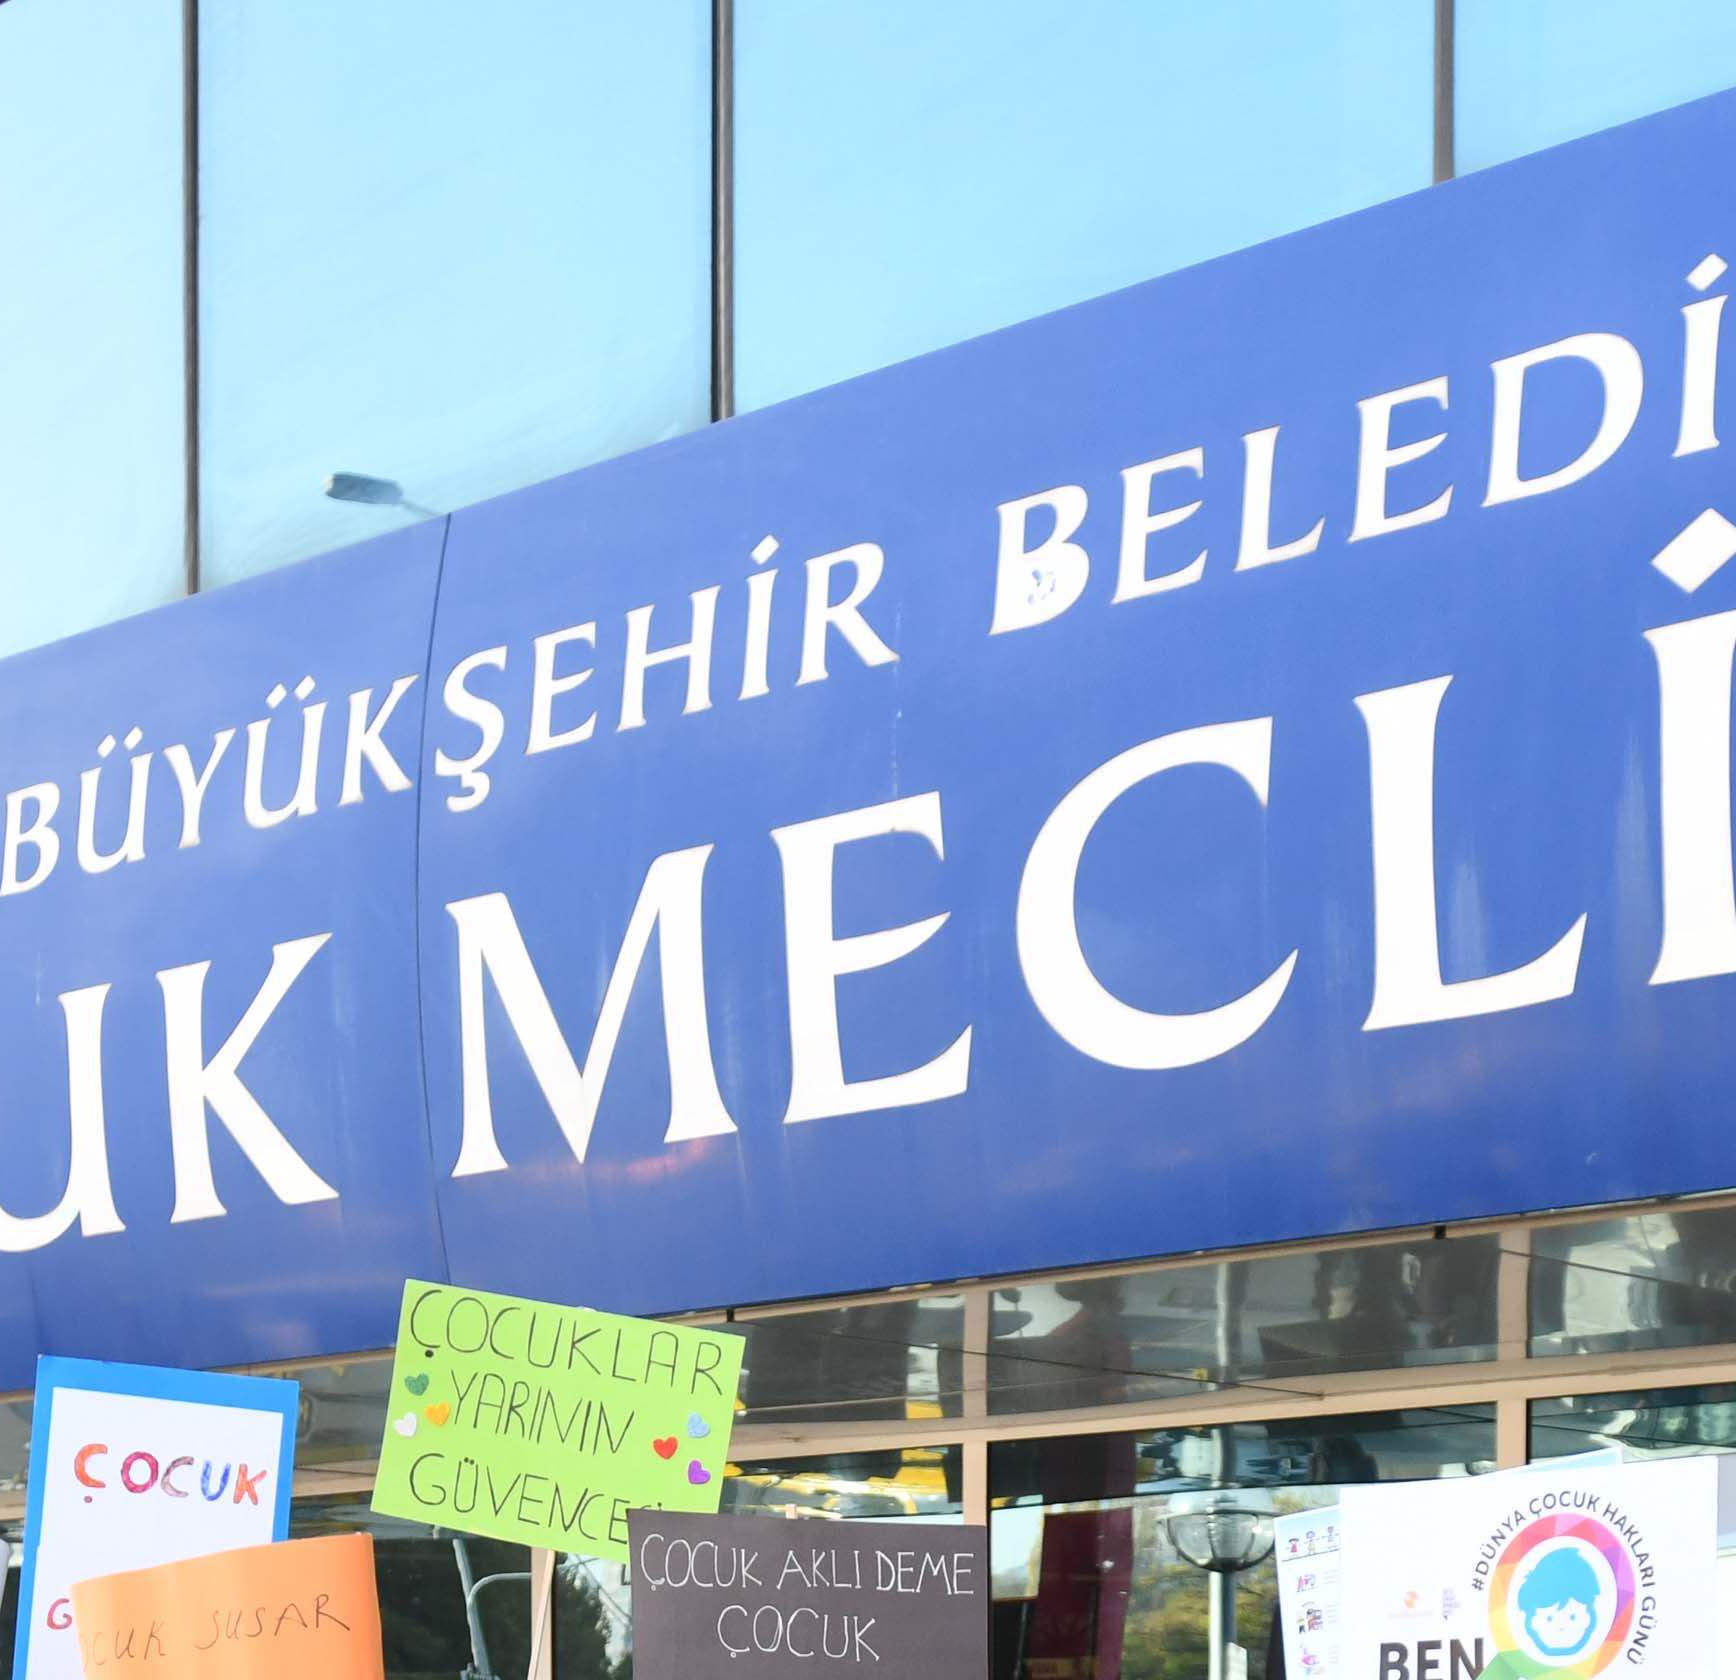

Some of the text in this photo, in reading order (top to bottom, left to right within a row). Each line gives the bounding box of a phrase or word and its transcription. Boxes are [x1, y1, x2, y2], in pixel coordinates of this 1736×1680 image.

[408, 1287, 726, 1397] ÇOCUKLAR
[450, 1369, 636, 1455] YARININ
[73, 1442, 267, 1504] ÇOCUK
[408, 1452, 664, 1546] GÜVENCE
[640, 1533, 975, 1596] ÇOCUK AKLI DEME
[1471, 1490, 1658, 1666] #DÜNYA ÇOCUK HAKLARI GÜNÜ
[79, 1593, 351, 1673] CUK SUSAR
[717, 1604, 880, 1662] ÇOCUK
